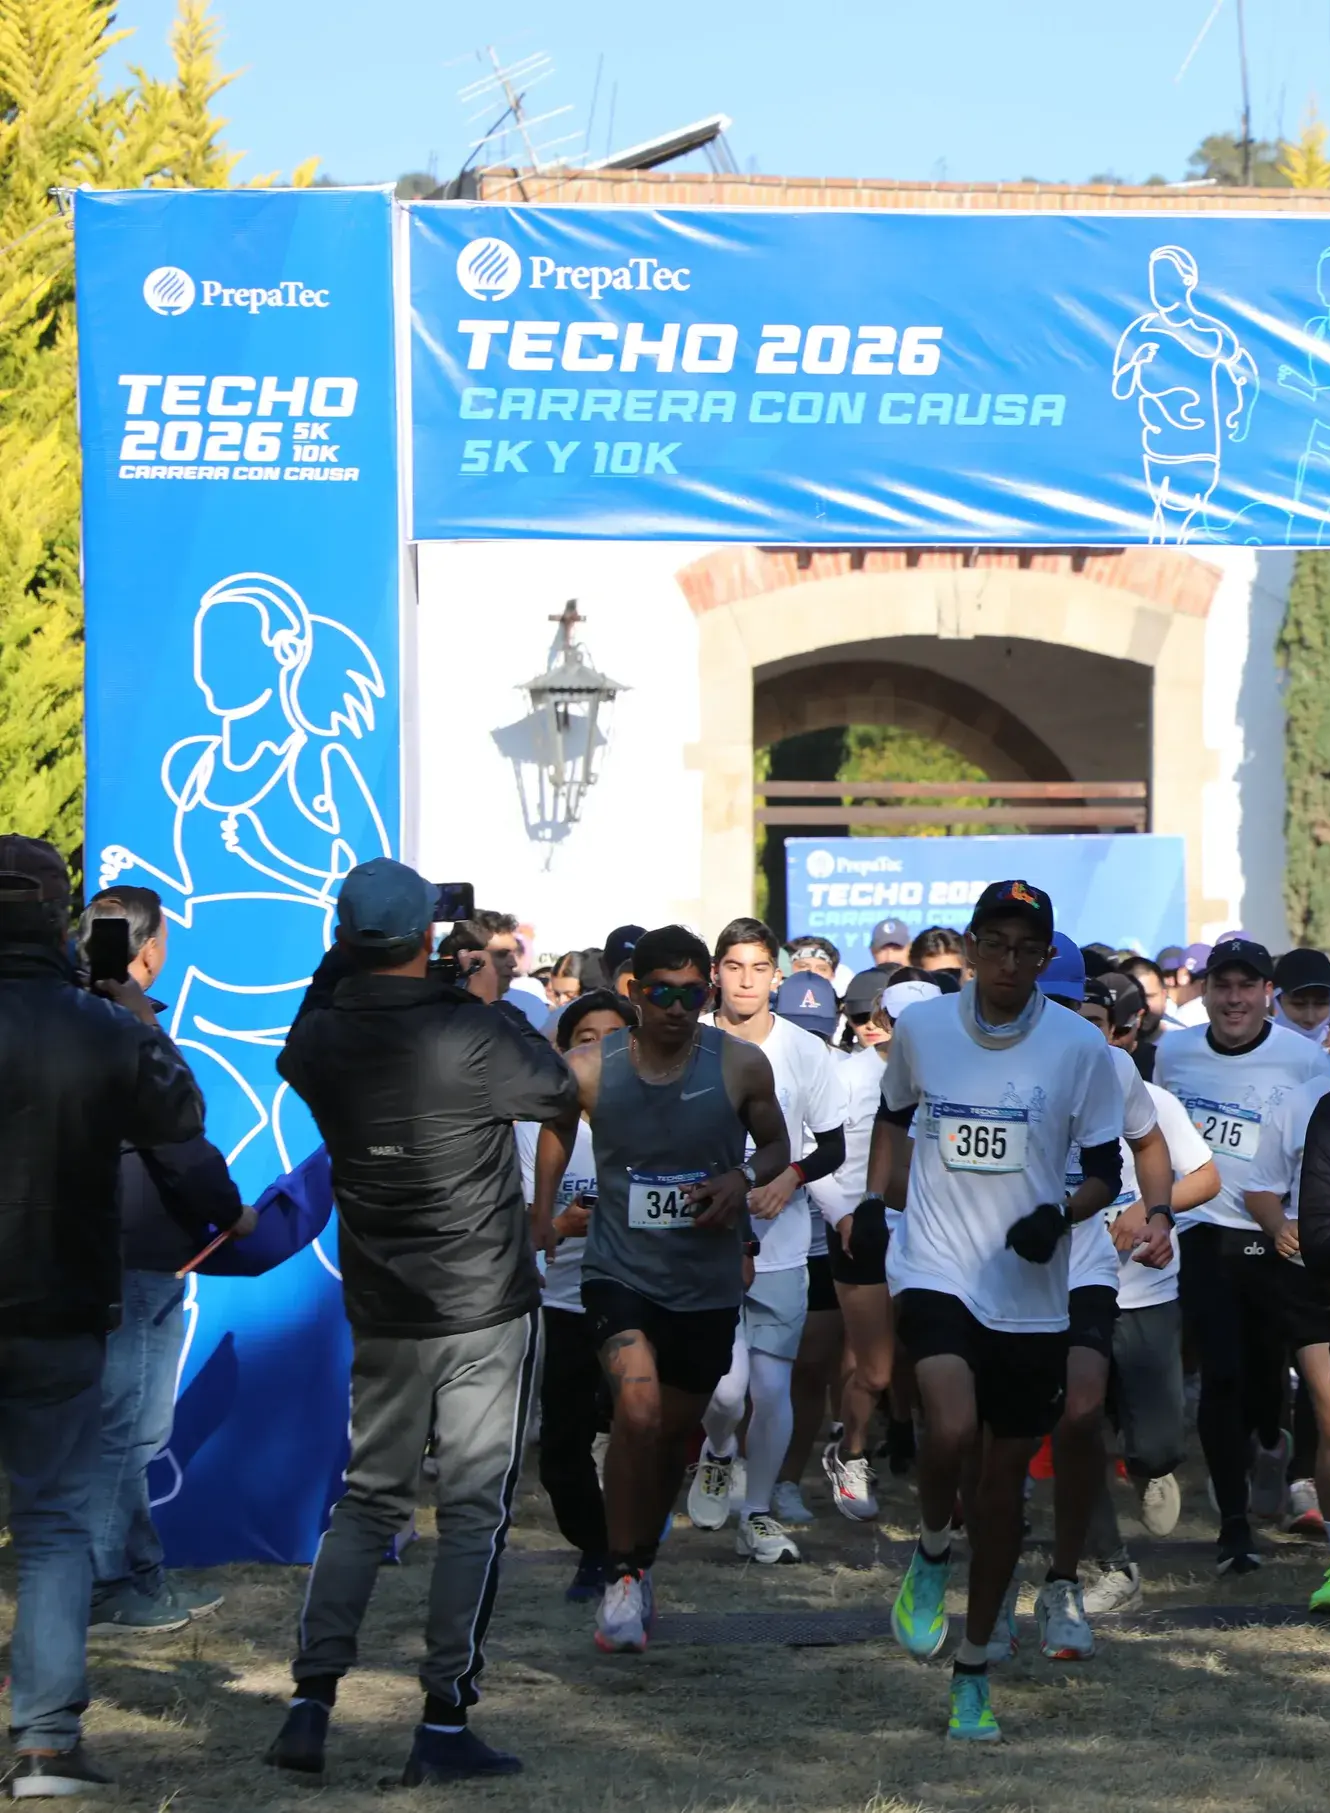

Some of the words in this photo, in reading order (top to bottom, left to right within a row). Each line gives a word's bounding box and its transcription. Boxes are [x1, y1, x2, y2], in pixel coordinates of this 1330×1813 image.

[529, 256, 691, 300] PrepaTec
[201, 279, 330, 315] PrepaTec
[458, 319, 739, 374] TECHO
[755, 324, 944, 376] 2026
[118, 374, 359, 418] TECHO
[458, 386, 737, 423] CARRERA
[748, 390, 865, 425] CON
[878, 392, 1067, 427] CAUSA
[118, 420, 282, 463] 2026
[293, 422, 330, 443] 5K
[293, 444, 340, 464] 10K
[459, 440, 533, 474] 5K
[546, 441, 582, 474] Y
[591, 441, 683, 476] 10K
[118, 464, 230, 481] CARRERA
[232, 466, 281, 481] CON
[283, 466, 360, 483] CAUSA
[807, 882, 924, 907] TECHO
[927, 881, 991, 905] 202
[957, 1124, 1007, 1160] 365
[1203, 1116, 1244, 1147] 215
[563, 1178, 598, 1192] ECH
[1243, 1241, 1266, 1256] alo
